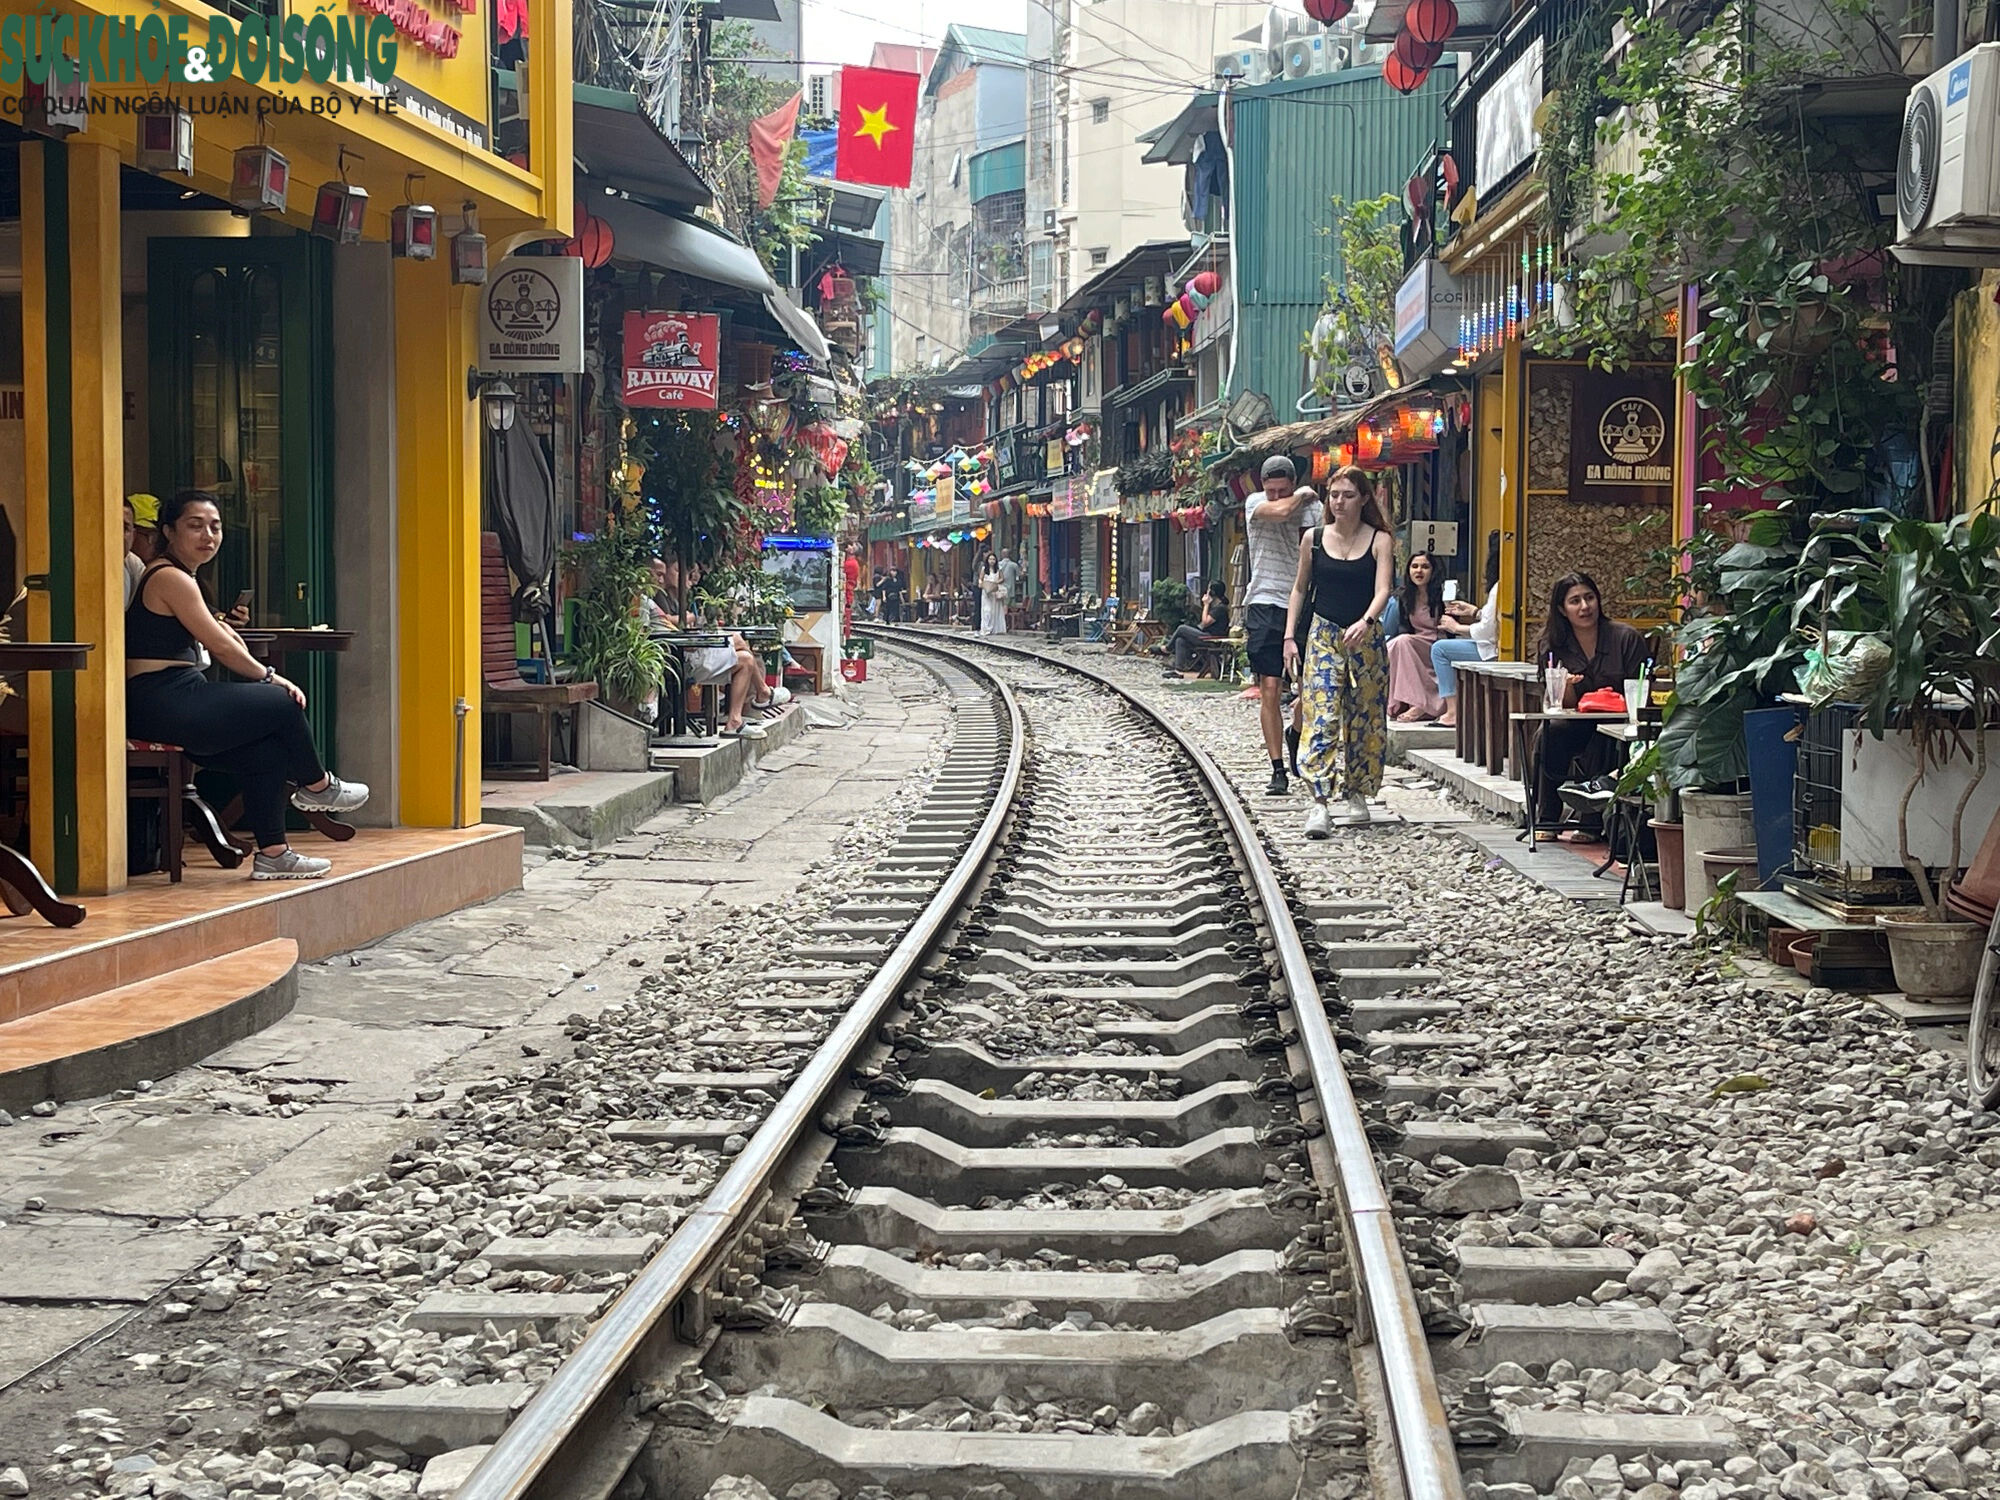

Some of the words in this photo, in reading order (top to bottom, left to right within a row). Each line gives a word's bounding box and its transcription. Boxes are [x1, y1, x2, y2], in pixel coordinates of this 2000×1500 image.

[627, 371, 714, 391] RAILWAY
[658, 389, 684, 400] Café
[1586, 464, 1601, 479] GA
